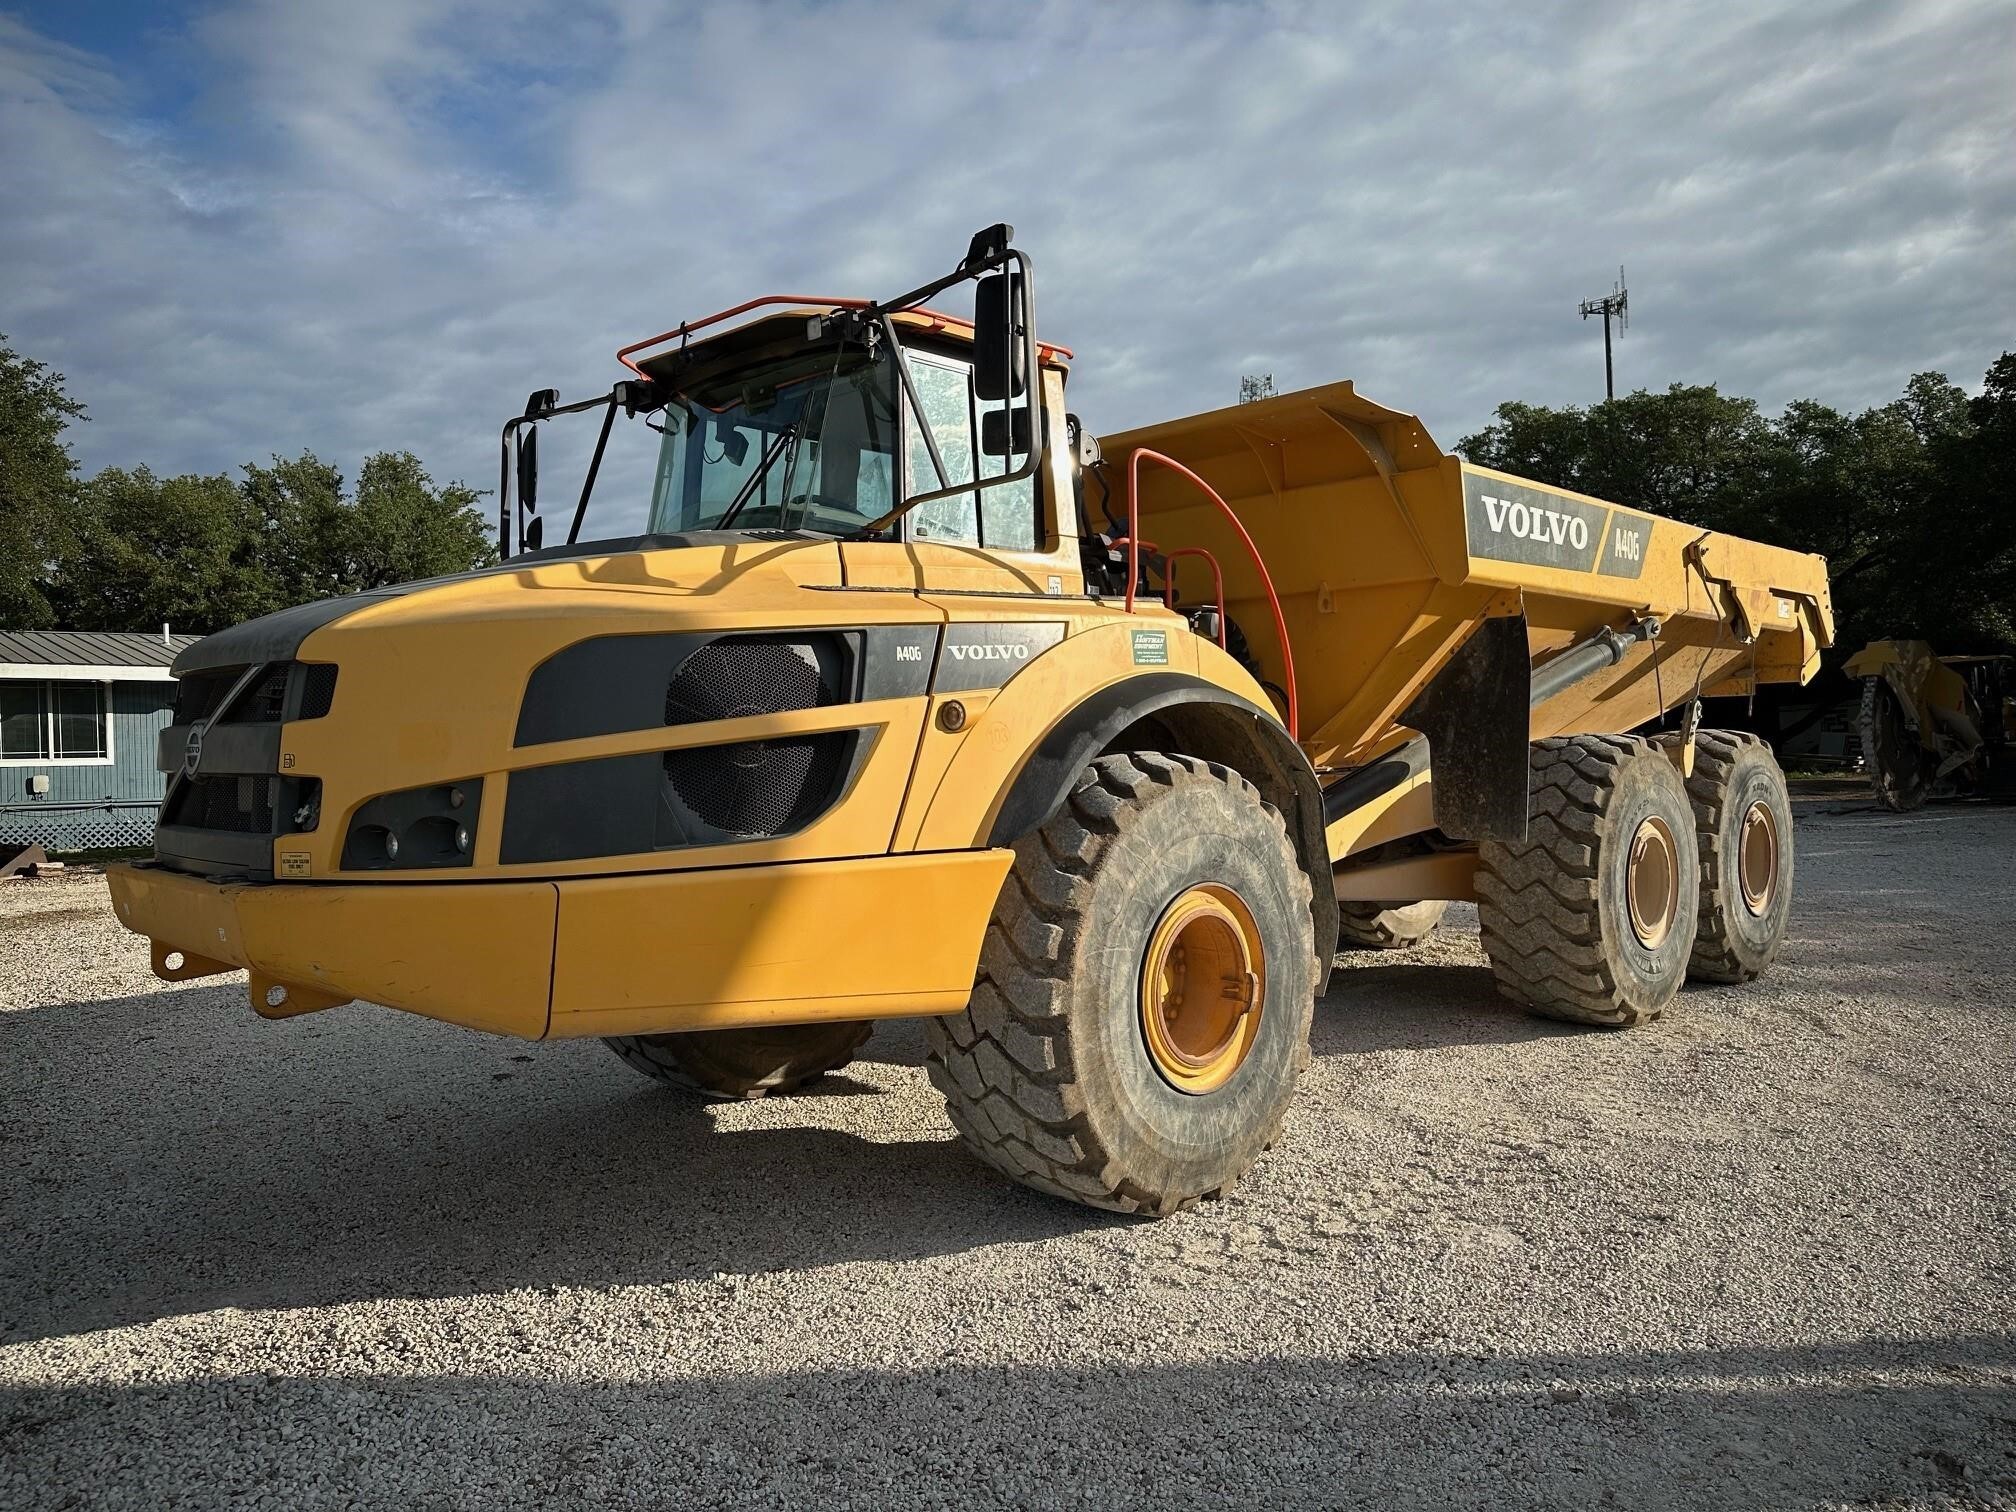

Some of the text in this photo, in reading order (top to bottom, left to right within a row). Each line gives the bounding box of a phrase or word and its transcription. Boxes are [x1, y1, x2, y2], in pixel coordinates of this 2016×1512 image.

[1481, 495, 1640, 561] VOLVO A40G
[896, 646, 921, 661] A40G
[947, 644, 1029, 660] VOLVO
